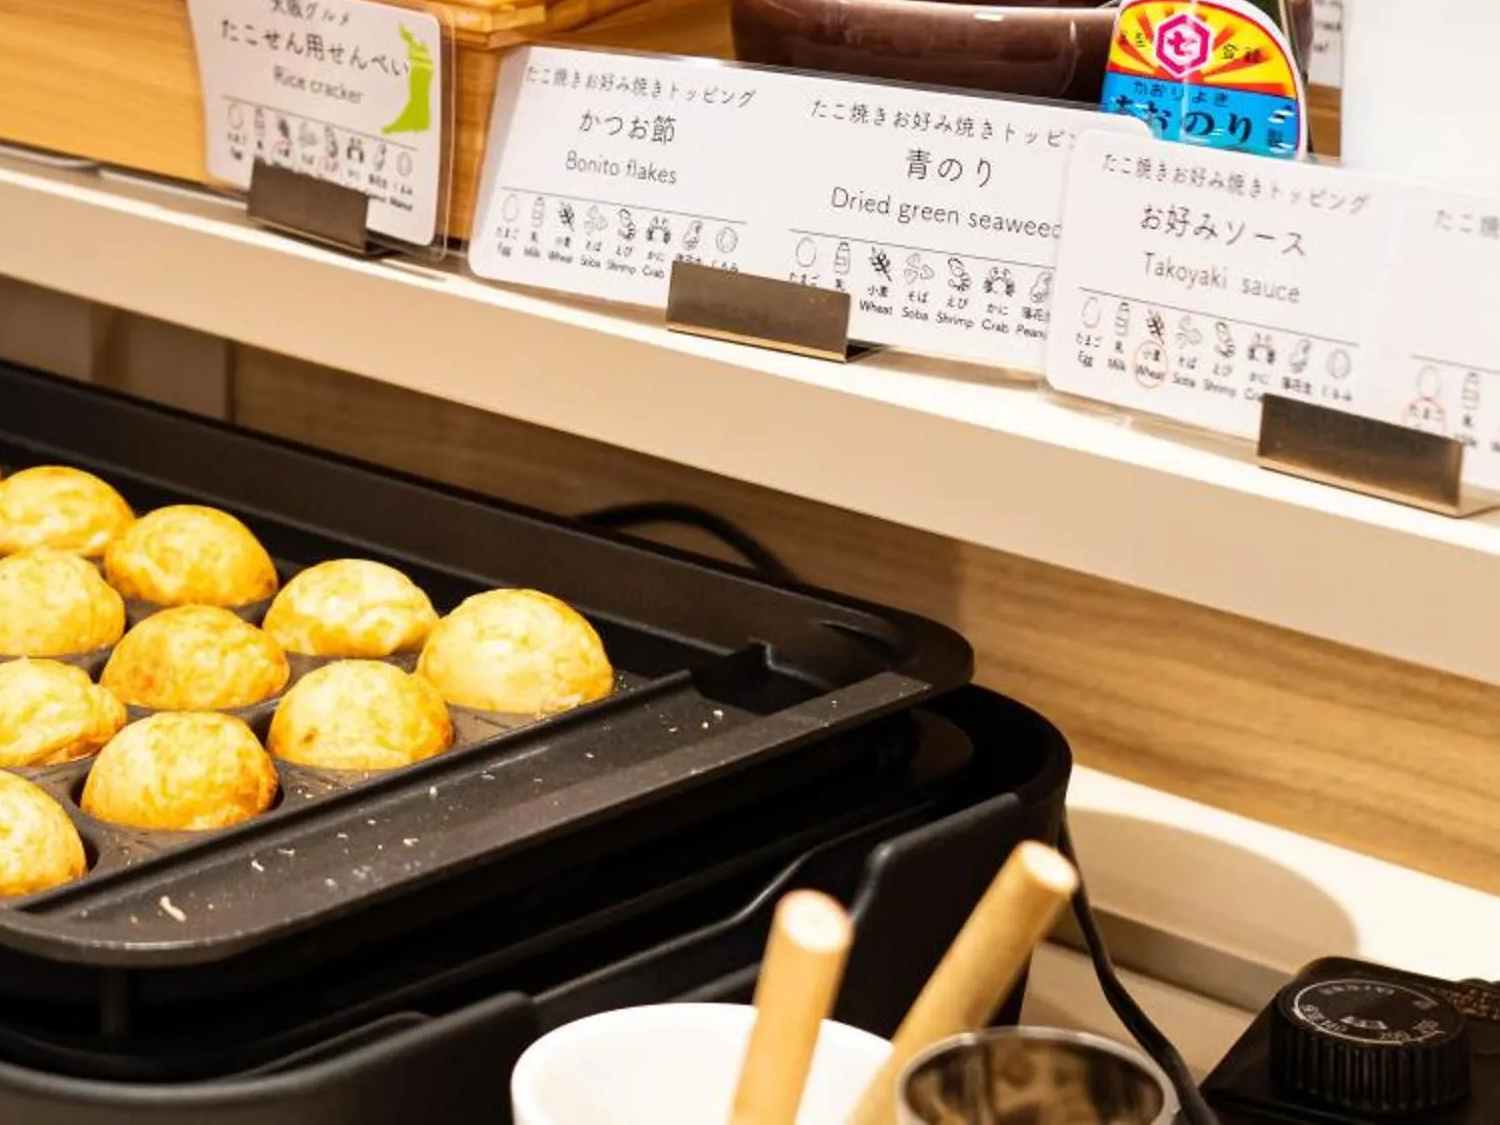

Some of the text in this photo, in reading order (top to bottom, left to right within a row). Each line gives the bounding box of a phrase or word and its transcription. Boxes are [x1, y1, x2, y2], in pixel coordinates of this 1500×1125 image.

[221, 18, 410, 77] たこせん用せんべい
[309, 80, 364, 105] cracker
[579, 109, 677, 145] かつお節
[565, 149, 677, 185] Bonito flakes
[905, 147, 992, 188] 青のり
[831, 186, 891, 216] Dried
[897, 201, 960, 225] green
[1139, 203, 1306, 257] お好みソース
[1143, 250, 1300, 304] Takoyaki sauce
[859, 299, 893, 317] Wheat
[901, 306, 929, 323] Soba
[935, 310, 975, 330] Shrimp
[981, 317, 1010, 335] Crab
